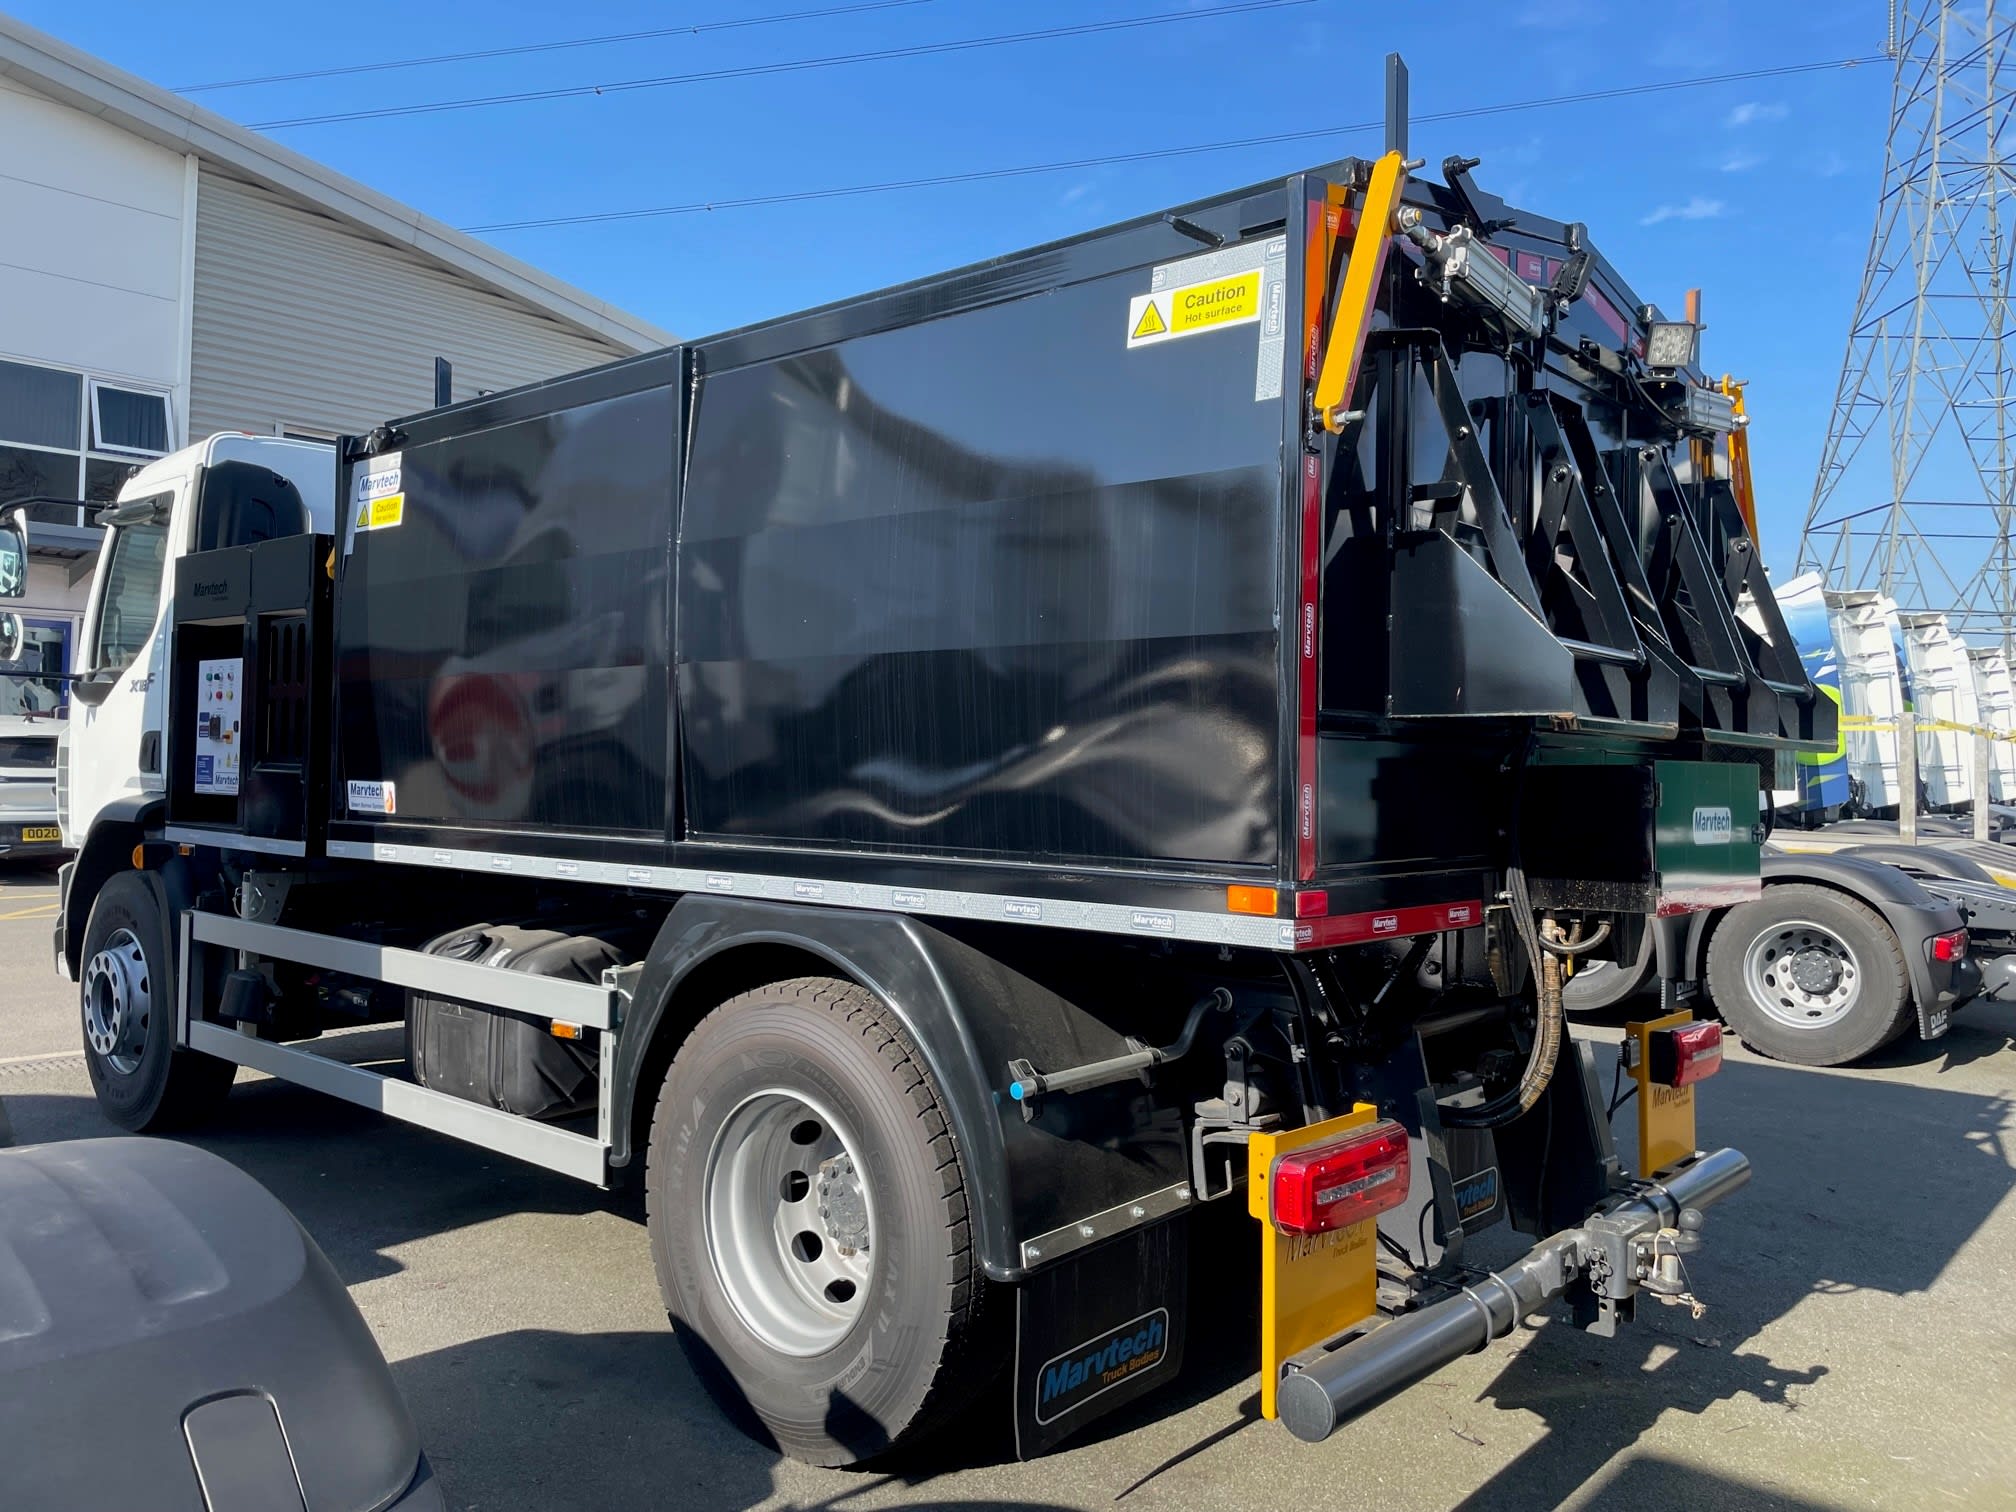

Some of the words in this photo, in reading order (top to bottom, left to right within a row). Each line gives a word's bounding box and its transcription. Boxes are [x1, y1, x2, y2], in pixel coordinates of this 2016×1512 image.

[1185, 285, 1246, 309] Caution
[1185, 314, 1202, 324] Hot
[1205, 303, 1242, 319] surface
[1266, 284, 1281, 333] Marvtech
[1310, 326, 1319, 376] Marvtech
[360, 474, 399, 492] Marvtech
[350, 782, 384, 798] Marvtech
[1694, 810, 1730, 832] Marvtech
[895, 894, 925, 904] Marvtech
[1005, 902, 1040, 914] Marvtech
[1133, 913, 1172, 926] Marvtech
[1449, 909, 1470, 917] Marvtech
[1281, 926, 1312, 938] Marvtech
[1373, 918, 1397, 928] Marvtech
[1930, 1009, 1948, 1028] DAF
[1043, 1319, 1163, 1403] Marvtech
[1102, 1365, 1127, 1384] Truck
[1129, 1350, 1160, 1369] Bodies
